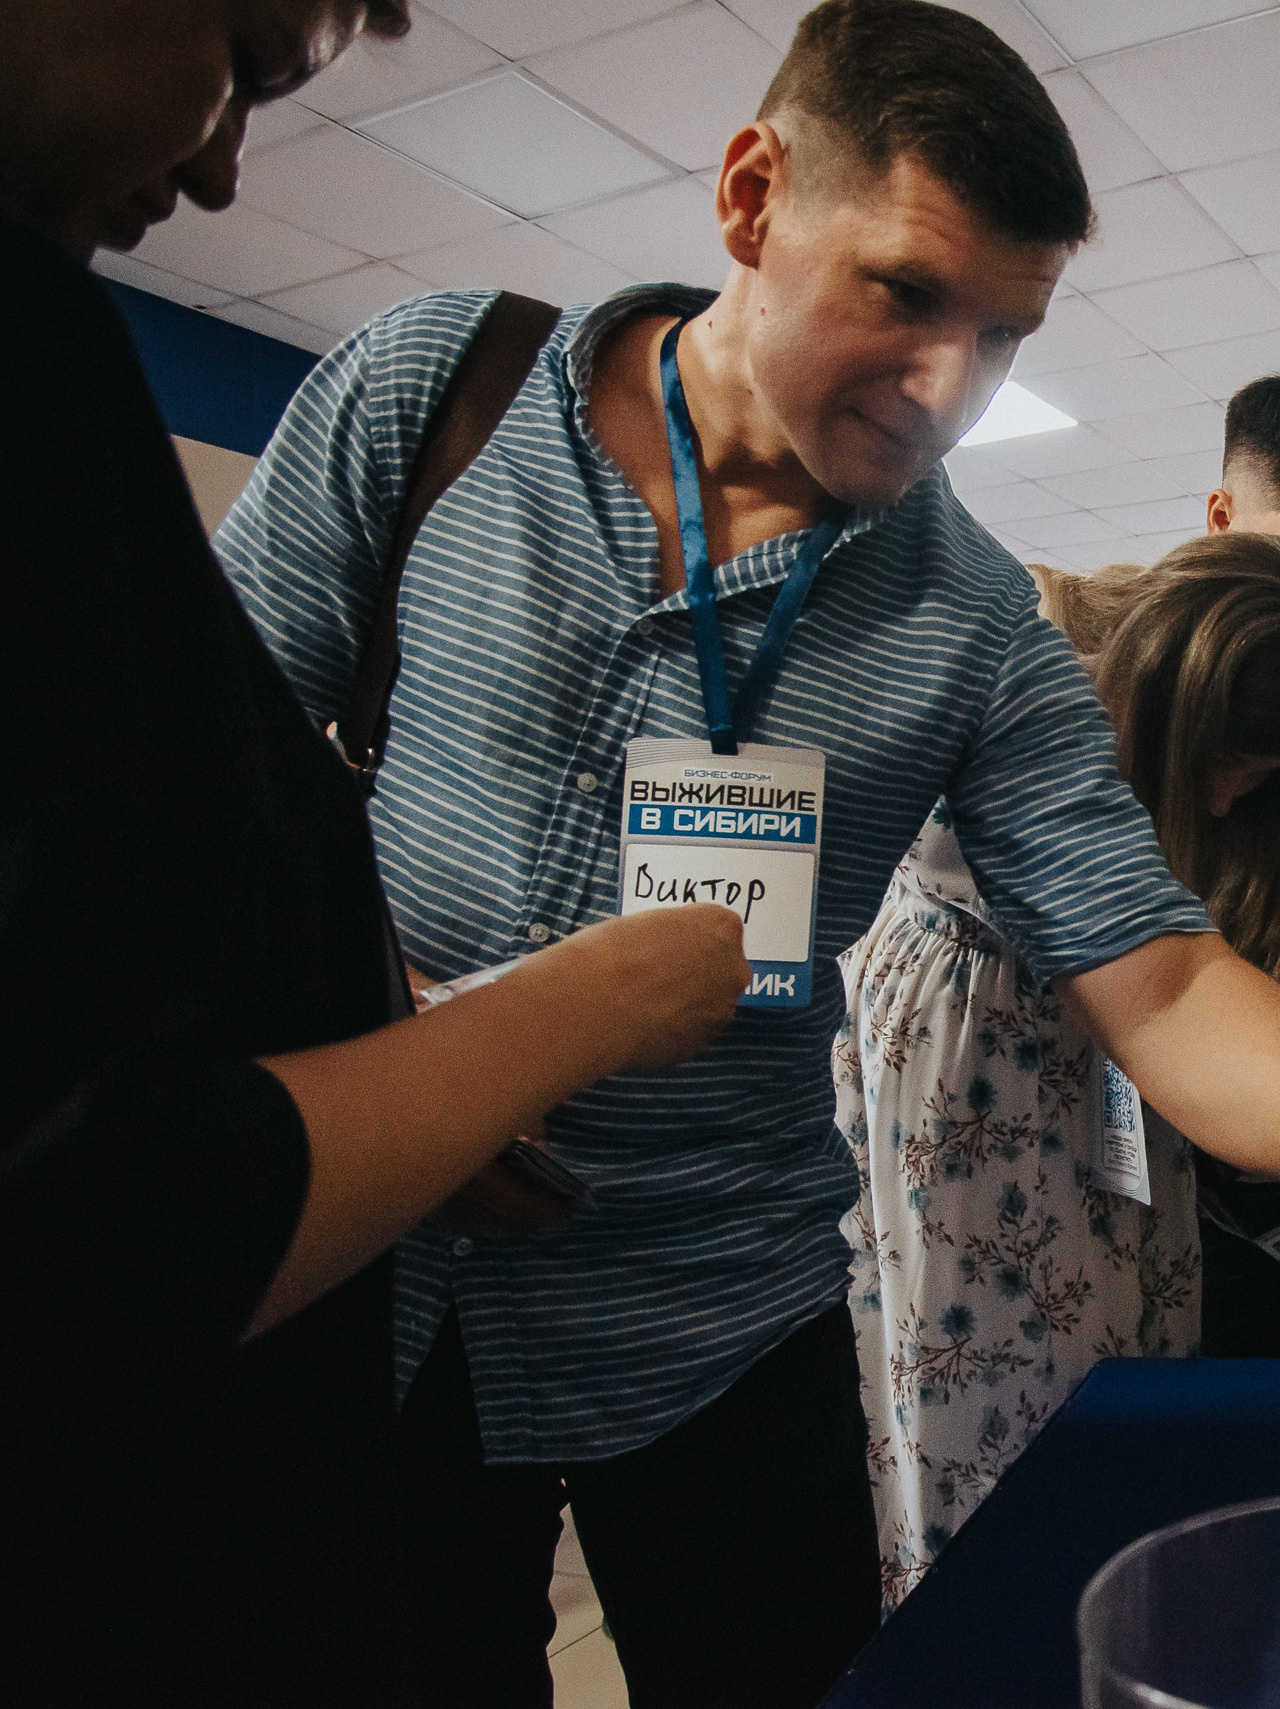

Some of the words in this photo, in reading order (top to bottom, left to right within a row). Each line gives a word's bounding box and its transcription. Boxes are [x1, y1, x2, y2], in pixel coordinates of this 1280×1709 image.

[684, 769, 772, 781] БИЗНЕС-ФОРУМ
[630, 781, 816, 812] ВЫЖИВШИЕ
[641, 808, 661, 829] В
[673, 809, 801, 838] СИБИРИ
[635, 863, 765, 924] Виктор
[745, 974, 795, 996] ИК
